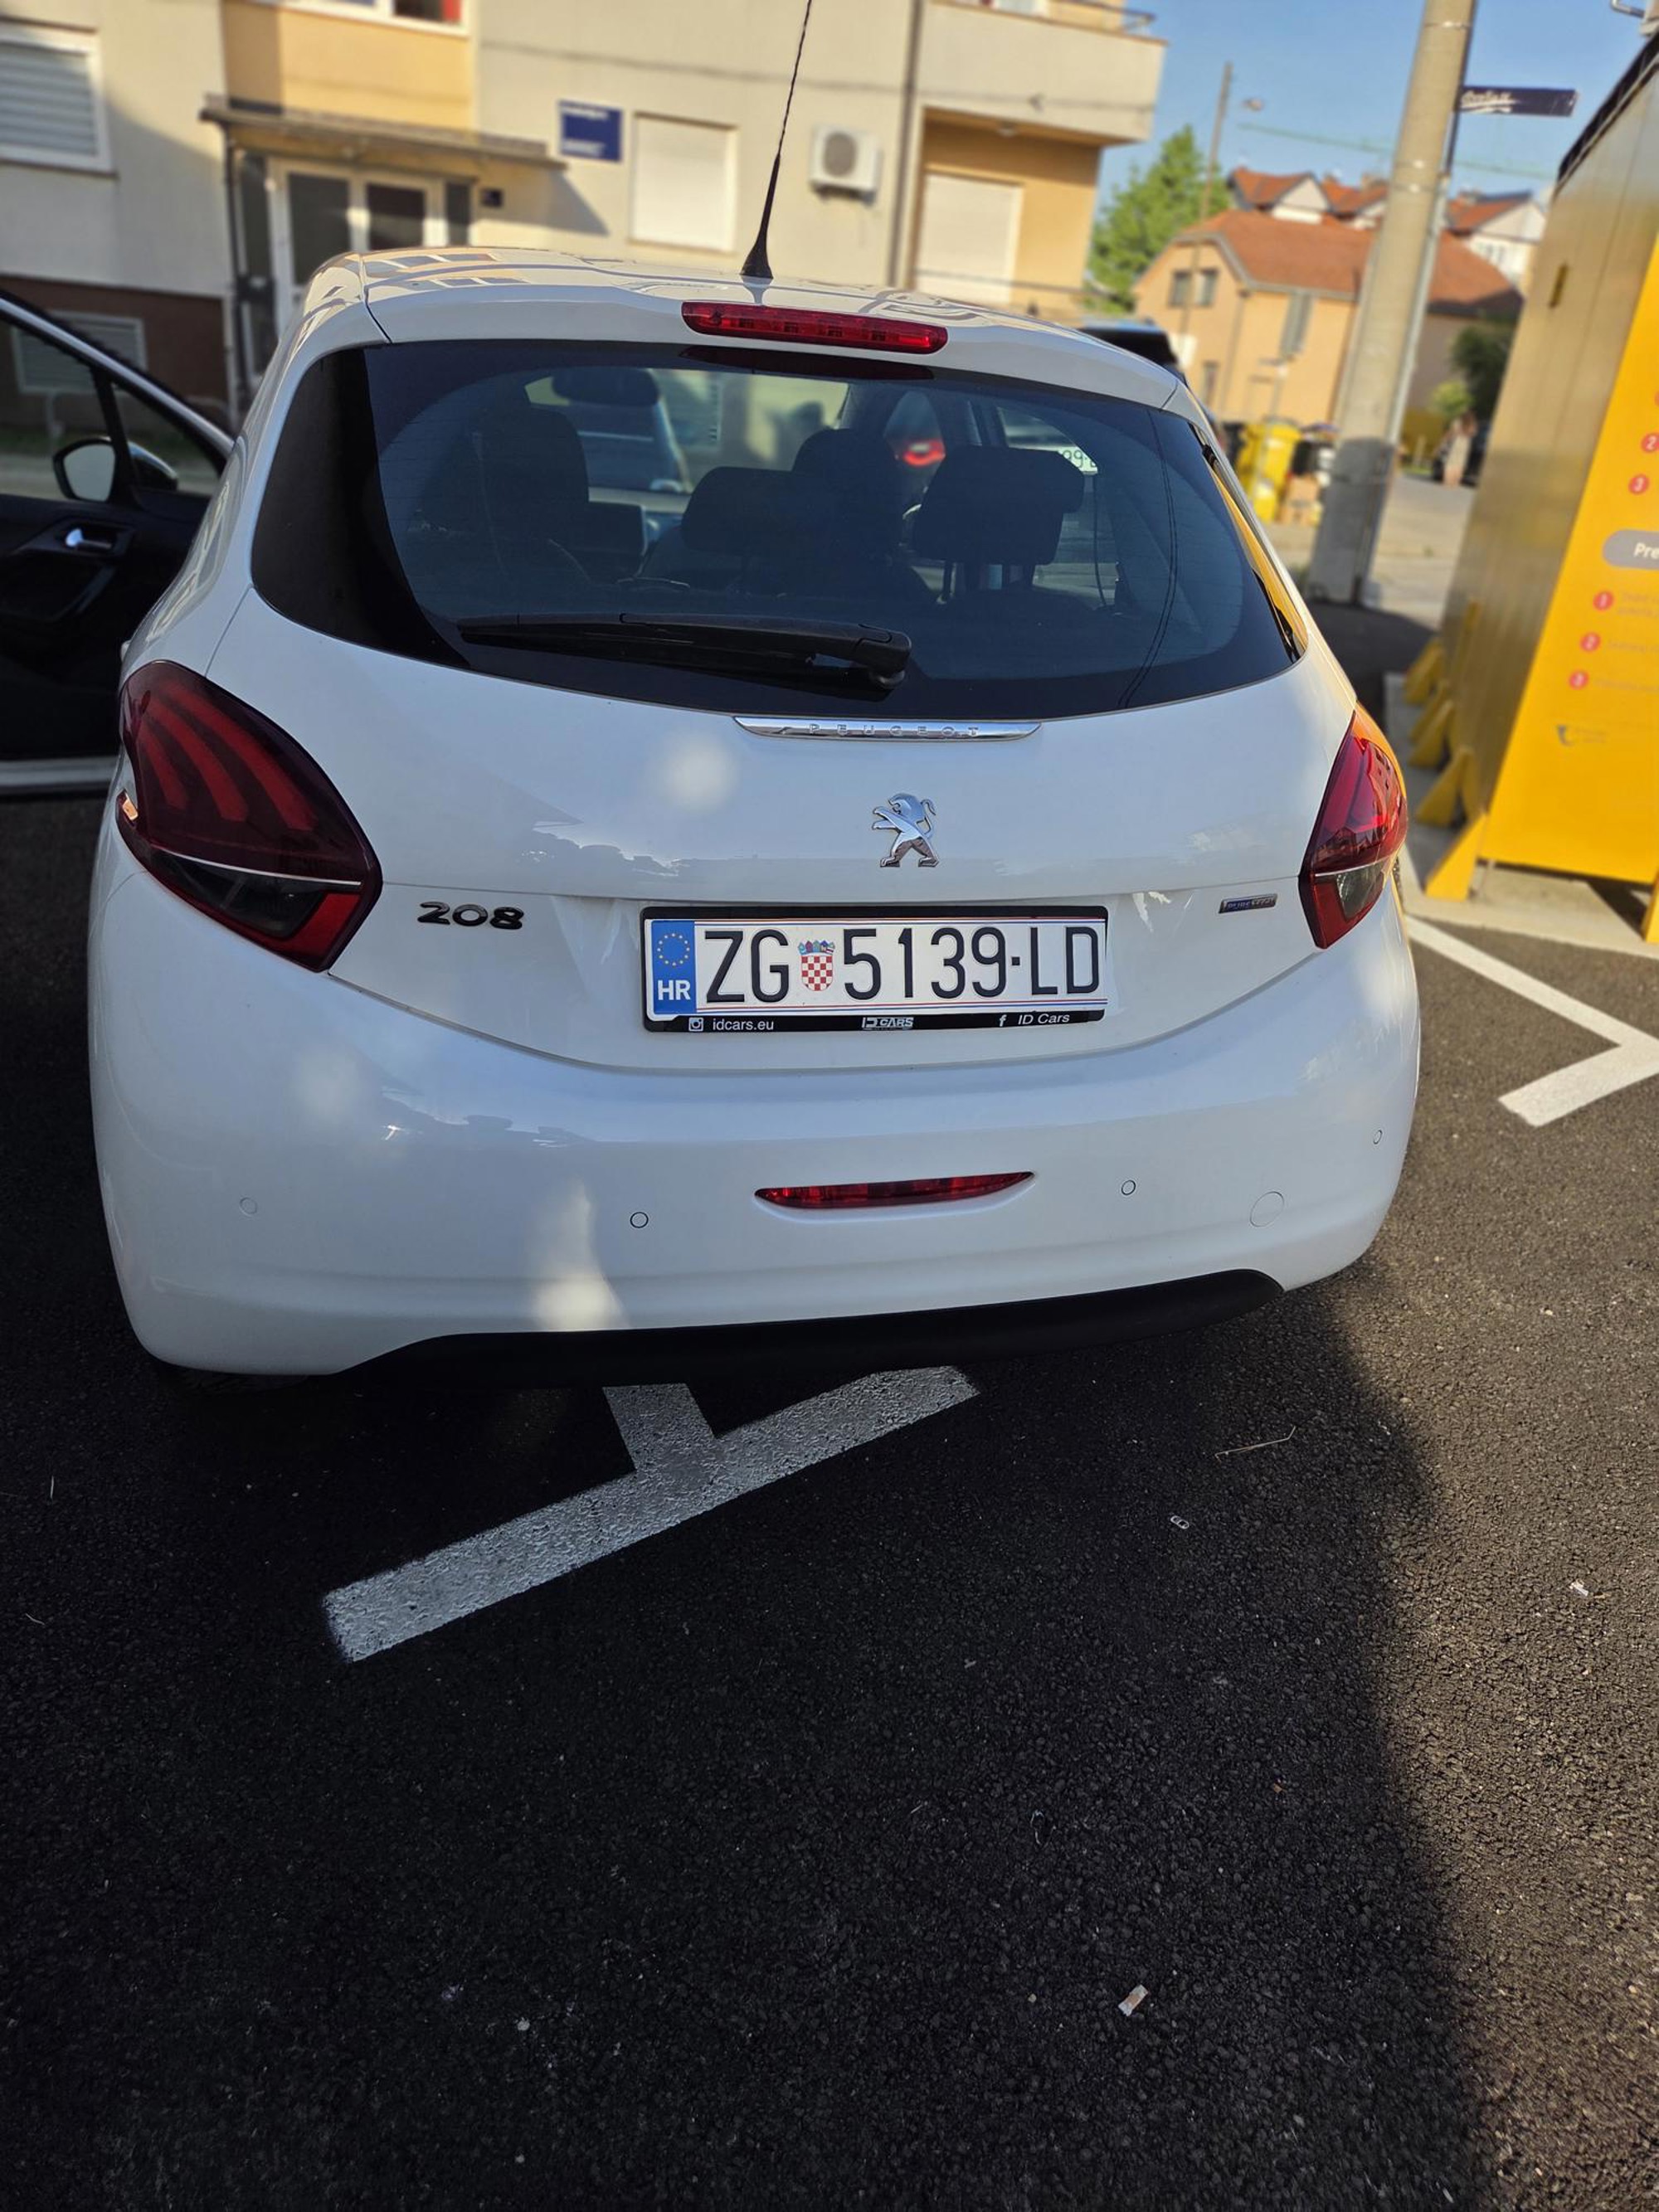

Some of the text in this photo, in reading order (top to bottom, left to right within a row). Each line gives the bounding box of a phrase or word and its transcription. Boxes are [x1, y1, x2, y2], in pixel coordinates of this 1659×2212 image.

[809, 722, 980, 737] PEUGEOT
[417, 901, 524, 930] 208
[704, 928, 789, 1004] ZG
[658, 980, 691, 1000] HR
[713, 1018, 774, 1031] idcars.eu
[879, 1017, 914, 1028] CARS
[1018, 1014, 1034, 1025] ID
[1038, 1014, 1070, 1024] Cars
